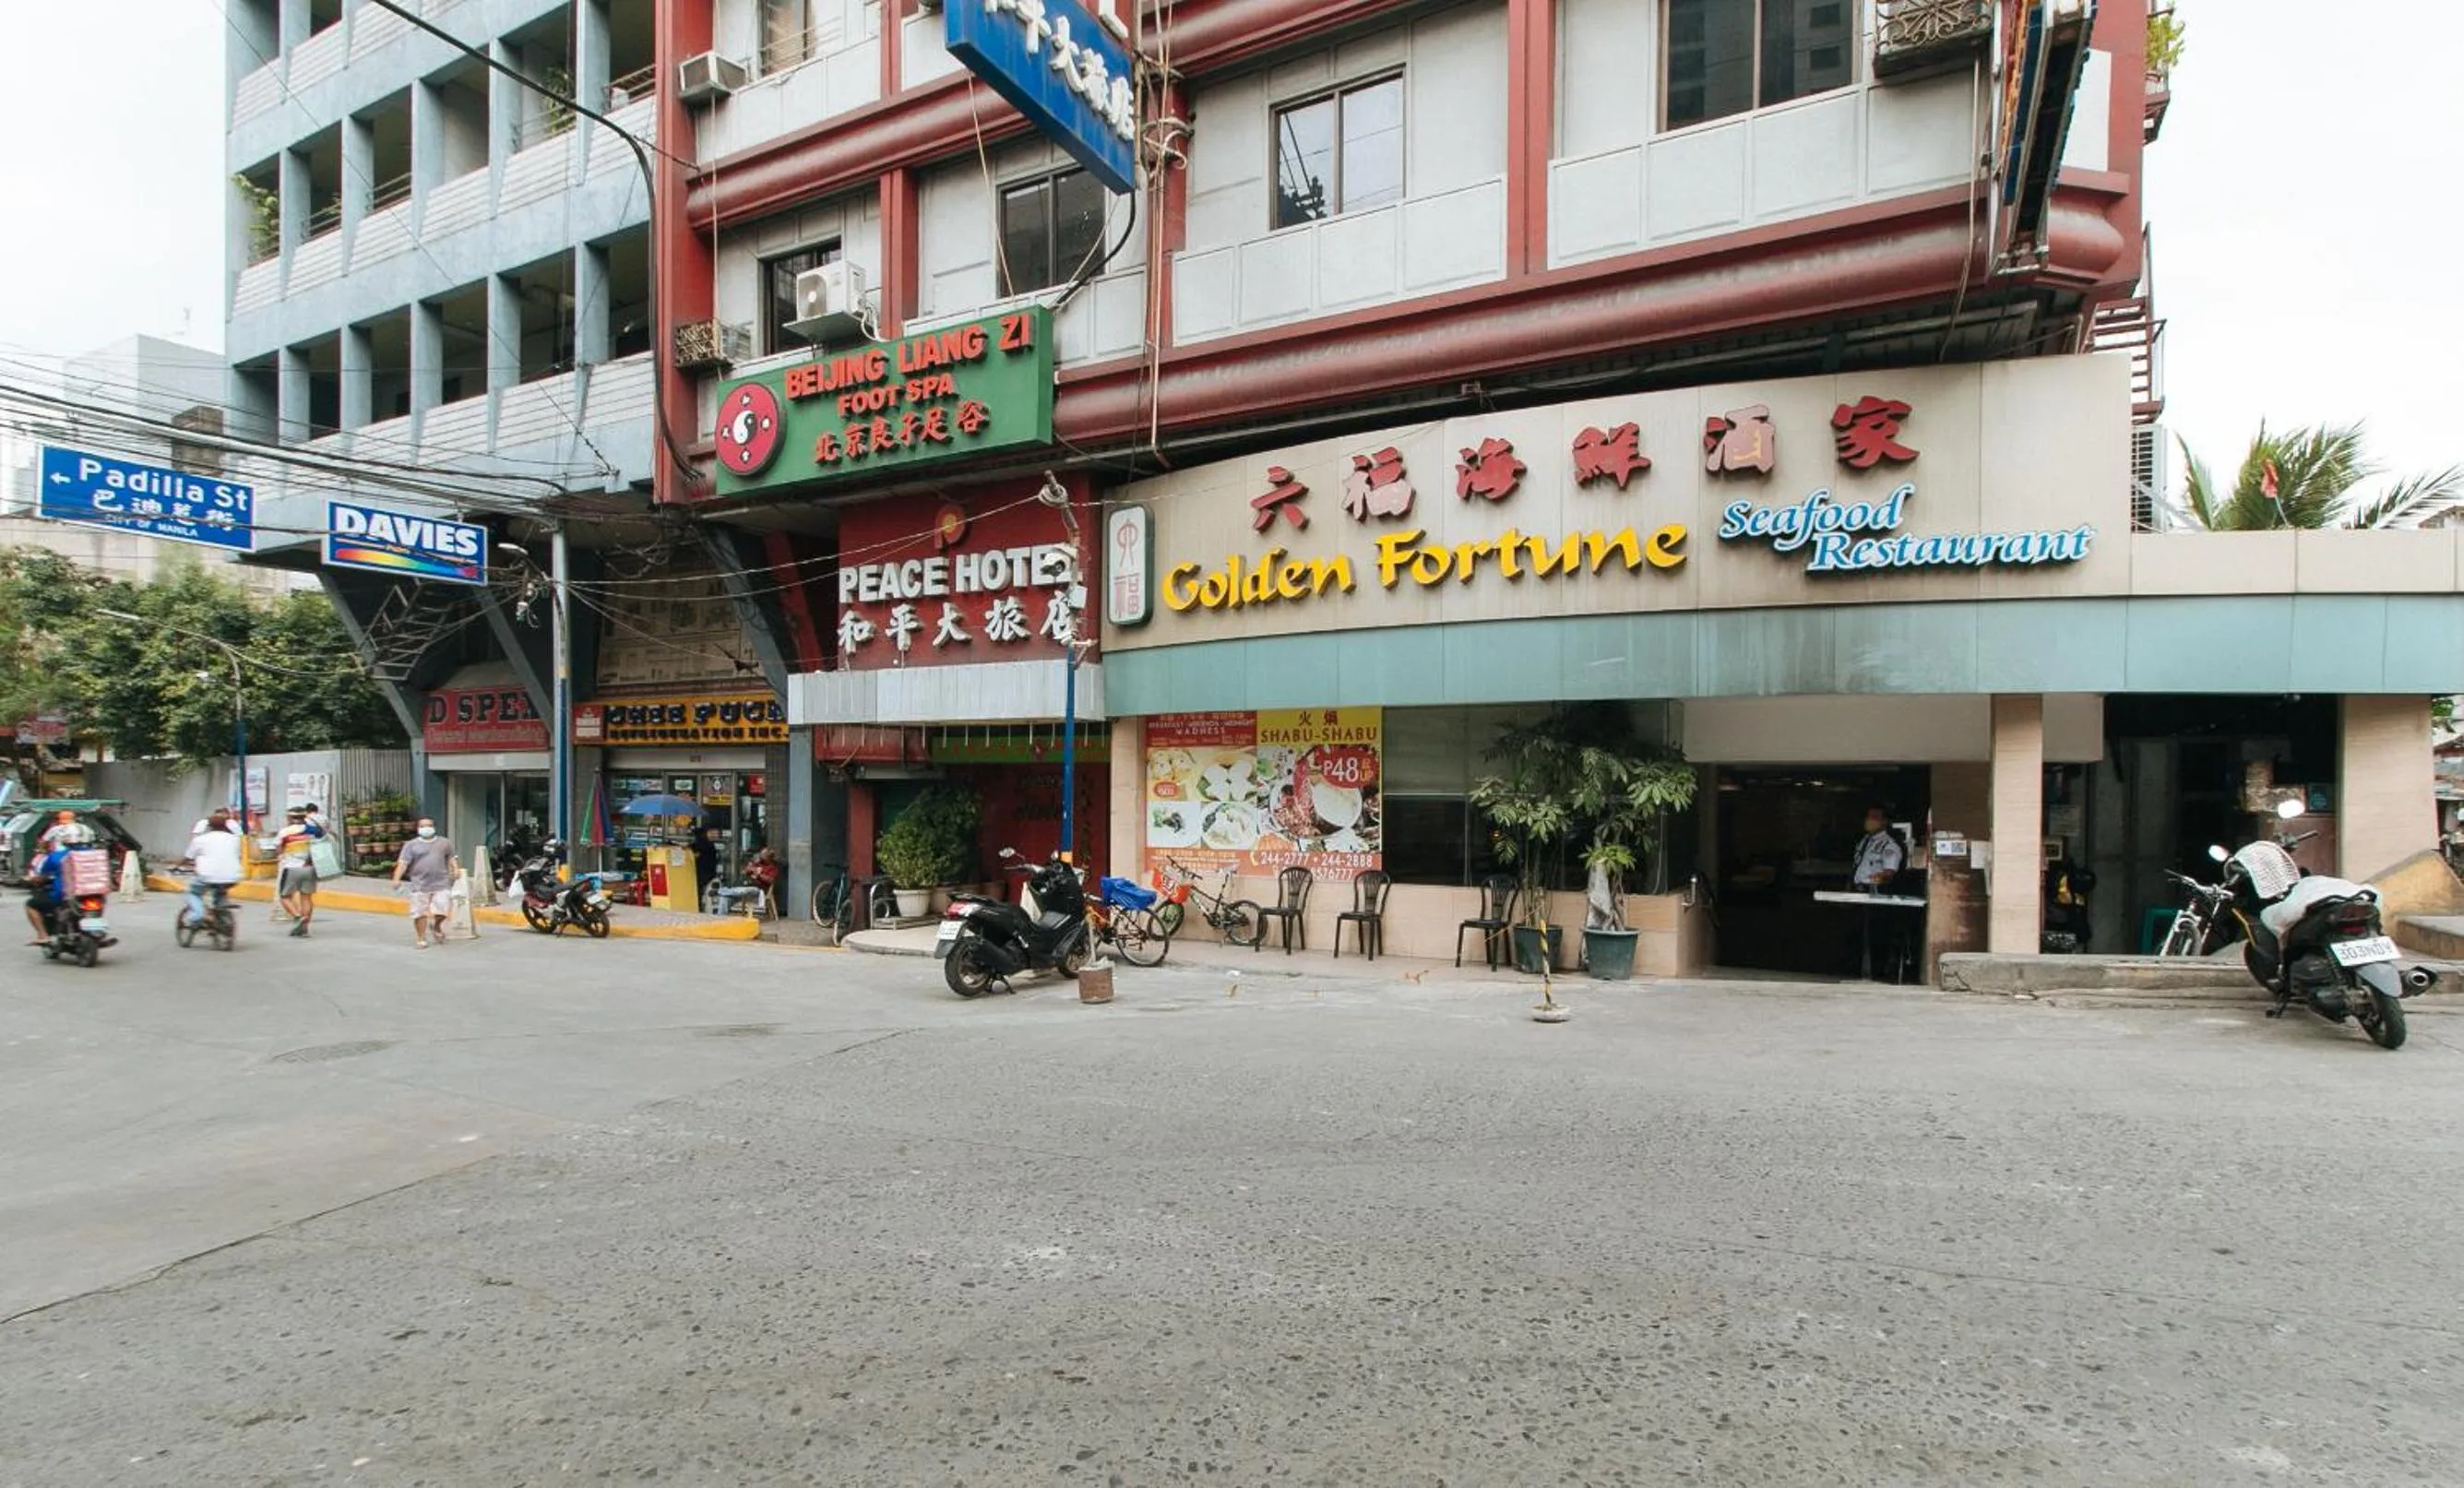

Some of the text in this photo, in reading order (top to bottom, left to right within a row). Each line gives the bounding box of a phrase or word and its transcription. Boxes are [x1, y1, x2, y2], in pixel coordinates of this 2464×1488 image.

[786, 313, 1033, 400] BEIJING LIANG ZI
[838, 373, 957, 416] FOOT SPA
[78, 458, 248, 511] Padilla St
[137, 518, 151, 530] OF
[157, 523, 199, 538] MANILA
[335, 506, 479, 556] DAVIES
[1719, 482, 2096, 577] Seafood Restaurant
[839, 557, 950, 604] PEACE
[1162, 523, 1688, 613] Golden Fortune
[1260, 726, 1377, 744] SHABU-SHABU
[1260, 851, 1373, 867] 244-2777 244-2888
